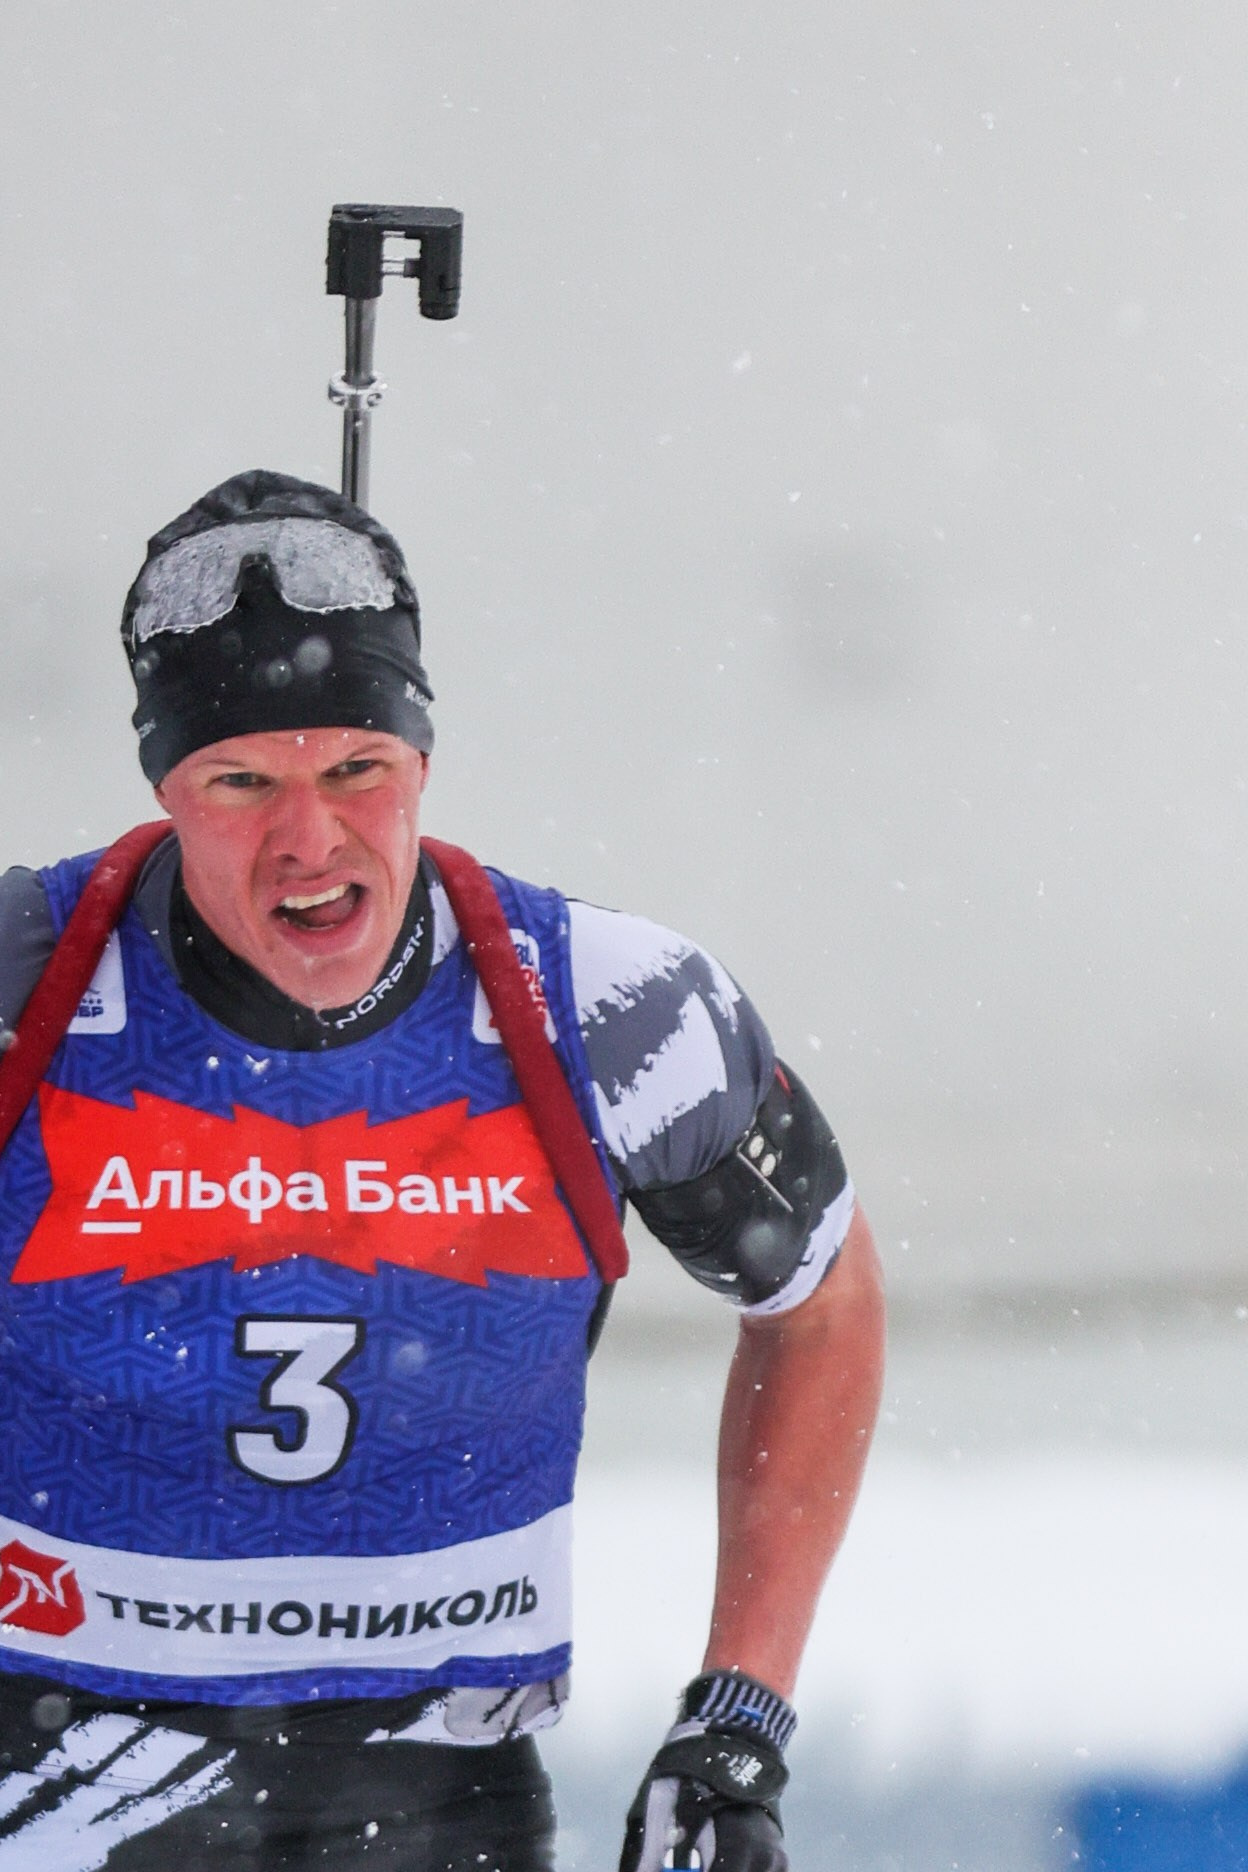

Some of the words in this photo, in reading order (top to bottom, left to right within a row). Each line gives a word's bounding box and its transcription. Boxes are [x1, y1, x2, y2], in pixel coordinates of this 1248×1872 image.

[85, 1155, 328, 1225] Альфа
[345, 1159, 532, 1214] Банк
[227, 1313, 366, 1487] 3
[95, 1575, 539, 1639] ТЕХНОНИКОЛЬ
